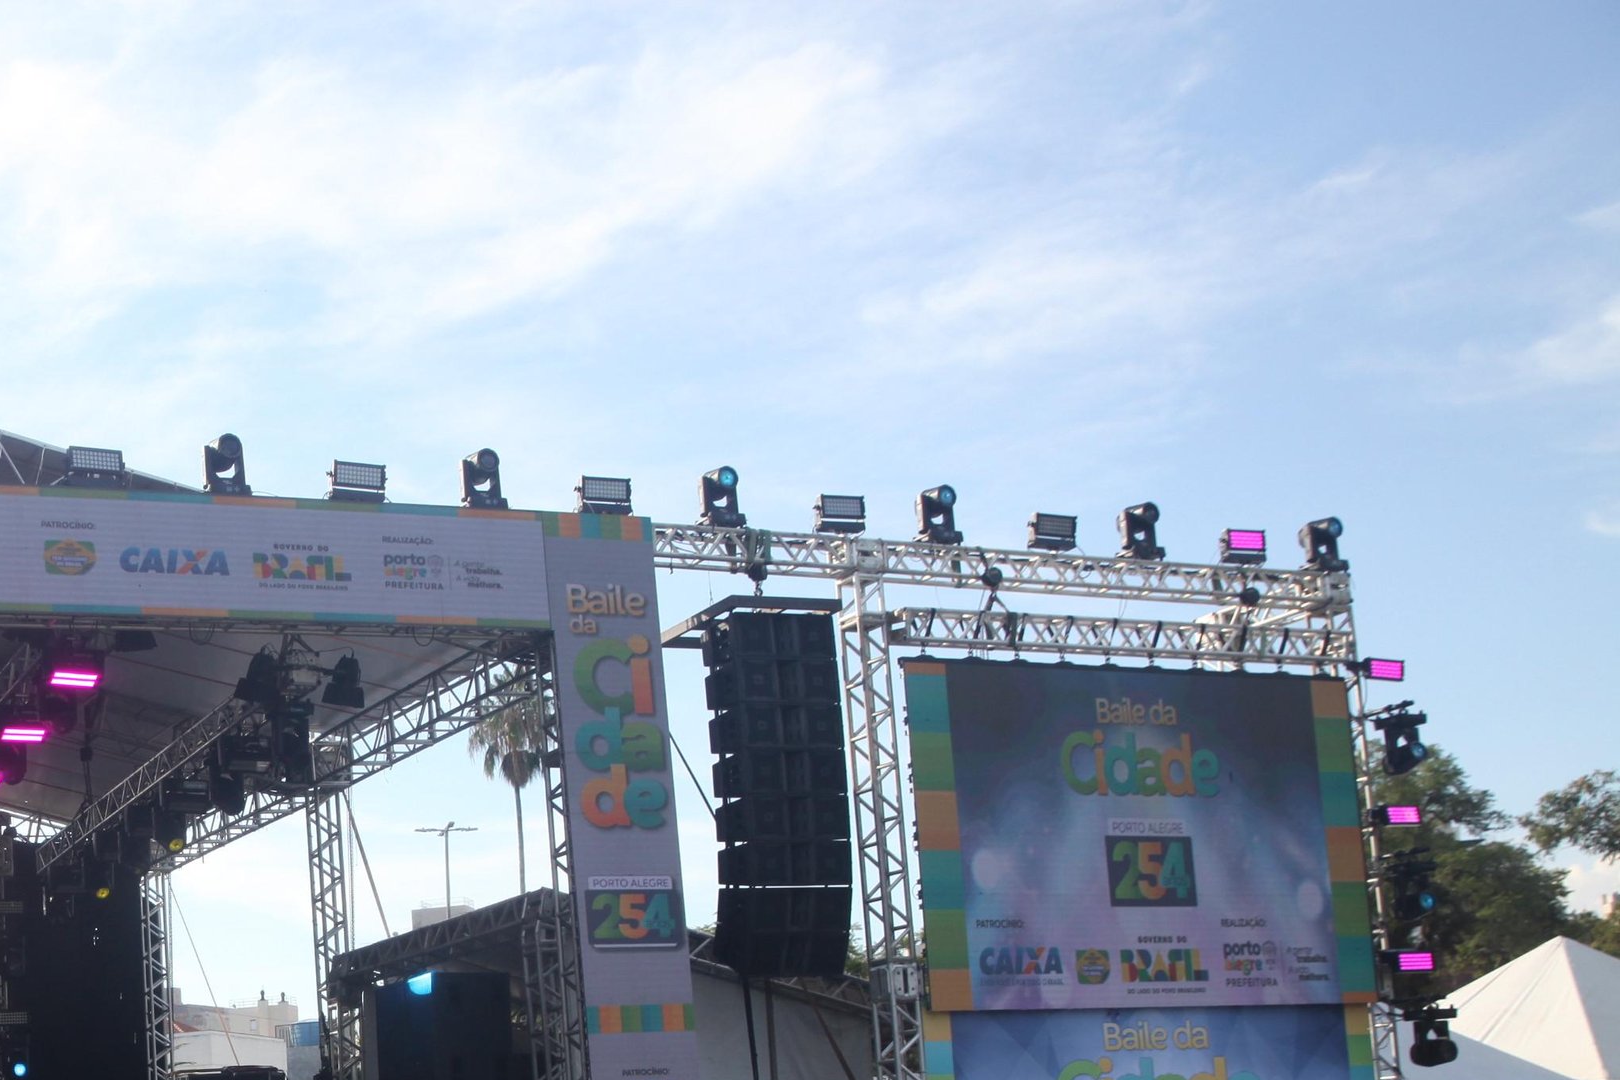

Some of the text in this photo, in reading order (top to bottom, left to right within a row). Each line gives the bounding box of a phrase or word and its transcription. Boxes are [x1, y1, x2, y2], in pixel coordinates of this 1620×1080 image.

[119, 546, 230, 577] CAIXA
[252, 552, 353, 582] BRASIL
[383, 553, 426, 567] porto
[383, 565, 428, 581] alegre
[385, 581, 445, 590] PREFEITURA
[565, 582, 647, 617] Baile
[568, 613, 599, 635] da
[572, 634, 656, 716] Ci
[1095, 697, 1178, 726] Baile da
[575, 706, 666, 773] da
[1060, 728, 1221, 798] Cidade
[580, 763, 668, 830] de
[1112, 821, 1184, 834] PORTO ALEGRE
[593, 878, 669, 888] PORTO ALEGRE
[1112, 840, 1191, 900] 254
[592, 892, 676, 940] 254
[1137, 935, 1173, 944] GOVERNO
[1223, 940, 1261, 959] porto
[979, 946, 1064, 976] CAIXA
[1119, 947, 1210, 983] BRASIL
[1224, 957, 1263, 976] alegre
[1225, 977, 1278, 987] PREFEITURA
[1102, 1019, 1211, 1051] Baile da
